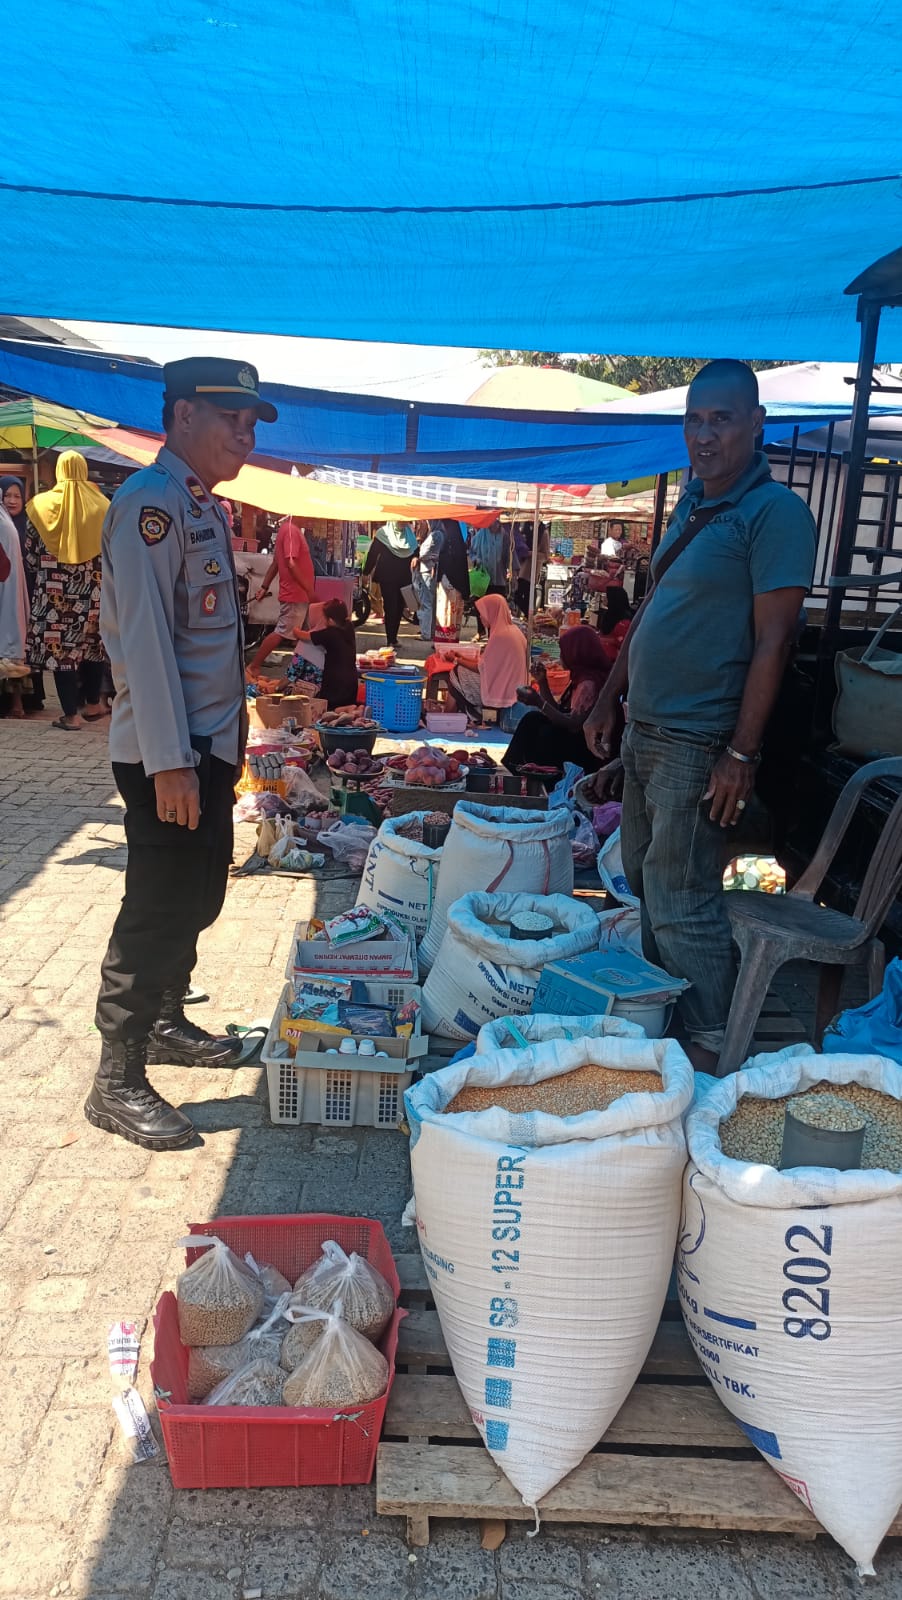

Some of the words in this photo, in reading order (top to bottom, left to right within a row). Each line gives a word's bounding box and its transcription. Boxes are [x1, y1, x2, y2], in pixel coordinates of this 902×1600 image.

[510, 996, 532, 1007] OLEH
[492, 1155, 527, 1242] SUPER
[491, 1250, 520, 1273] 12
[782, 1224, 833, 1341] 8202
[489, 1297, 519, 1328] SB
[723, 1375, 756, 1399] TBK.
